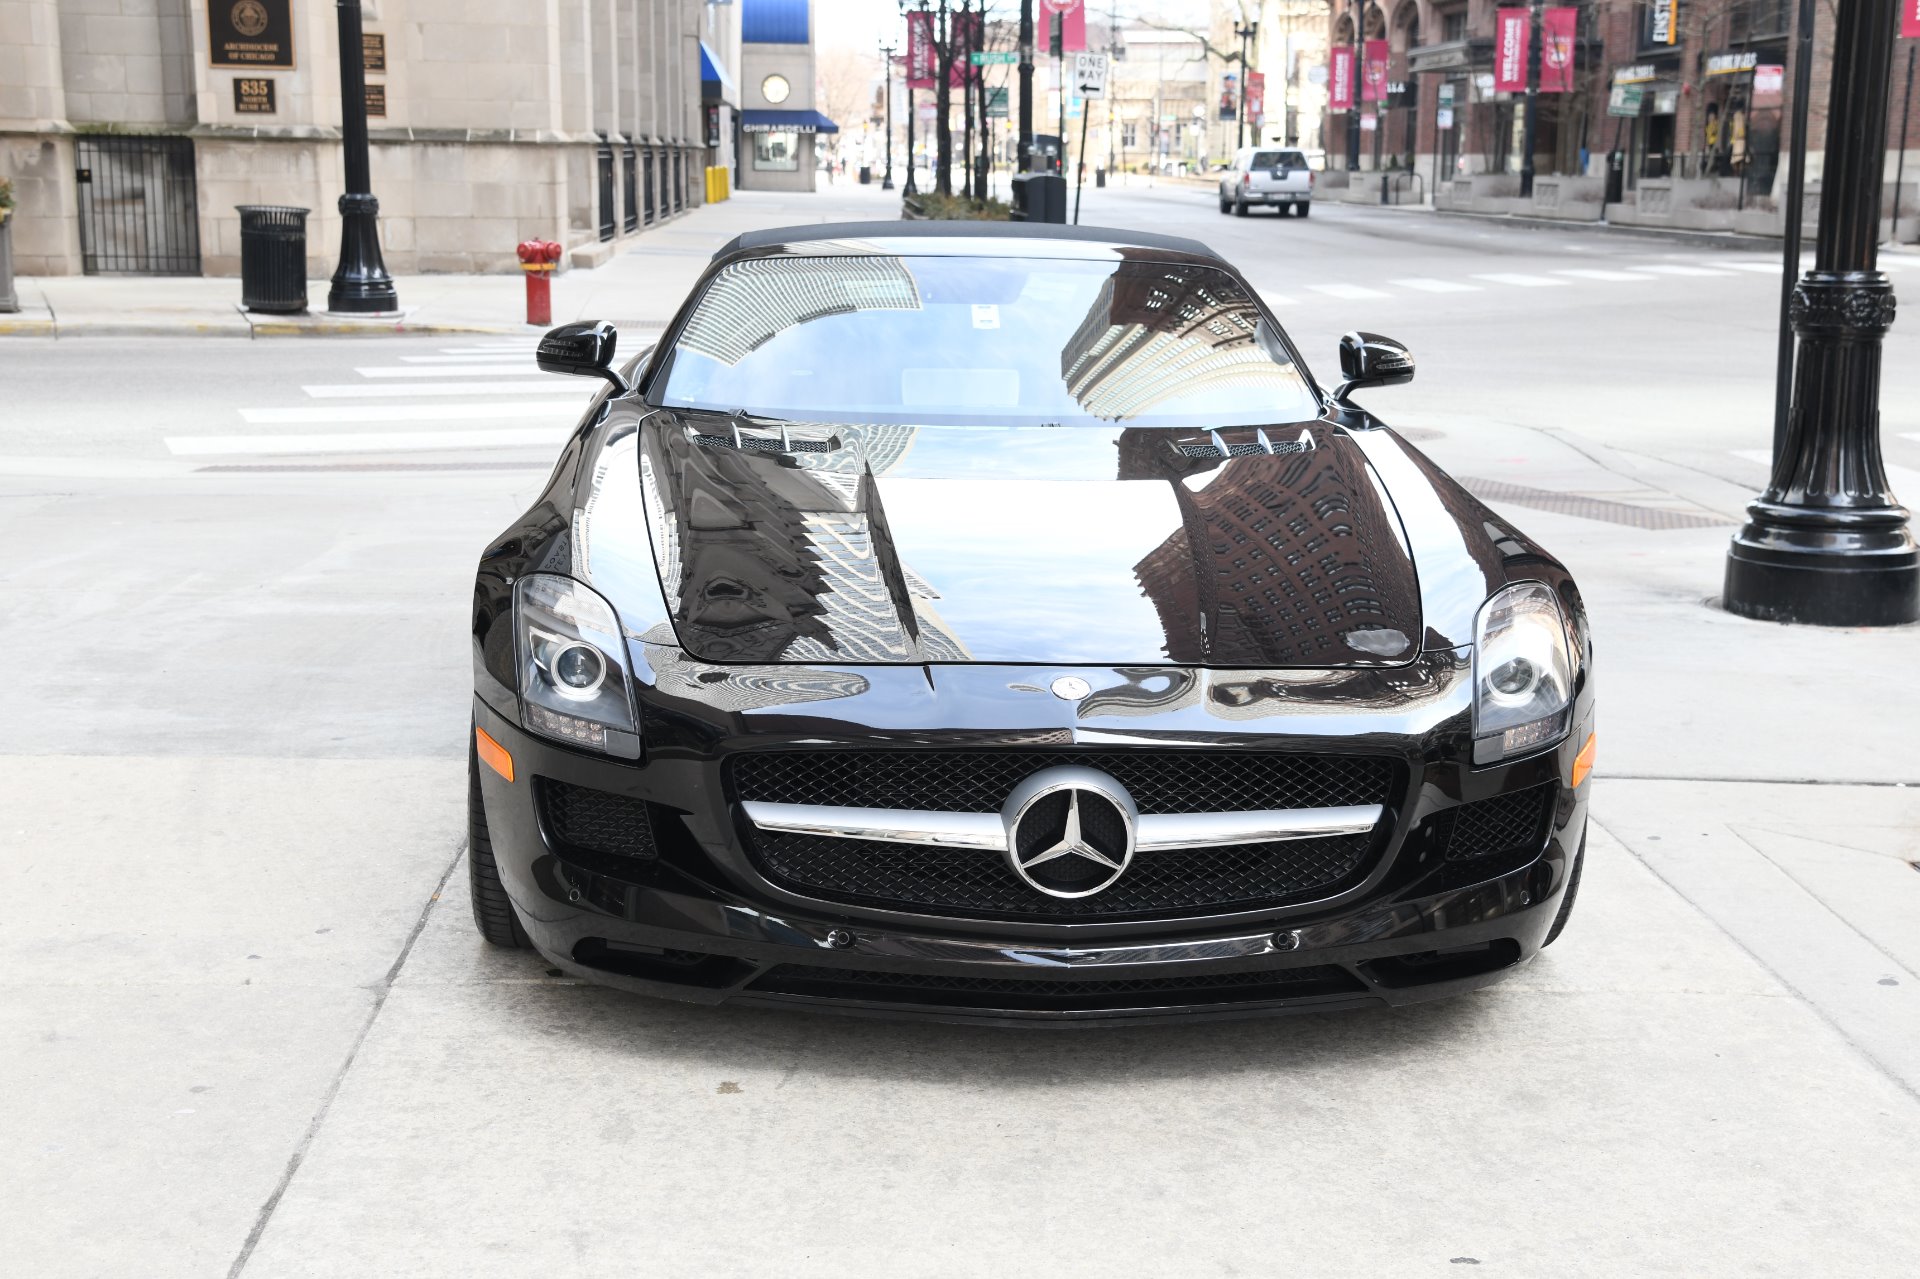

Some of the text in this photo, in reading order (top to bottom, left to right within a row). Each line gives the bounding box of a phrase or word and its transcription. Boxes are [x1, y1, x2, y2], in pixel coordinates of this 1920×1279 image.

[1502, 18, 1514, 82] WELCOME
[228, 52, 276, 60] OF CHICAGO
[1078, 57, 1104, 68] ONE
[1078, 70, 1104, 79] WAY
[1335, 53, 1344, 102] WELCOME
[241, 80, 268, 95] 835
[743, 124, 816, 133] GHIRARDELLI
